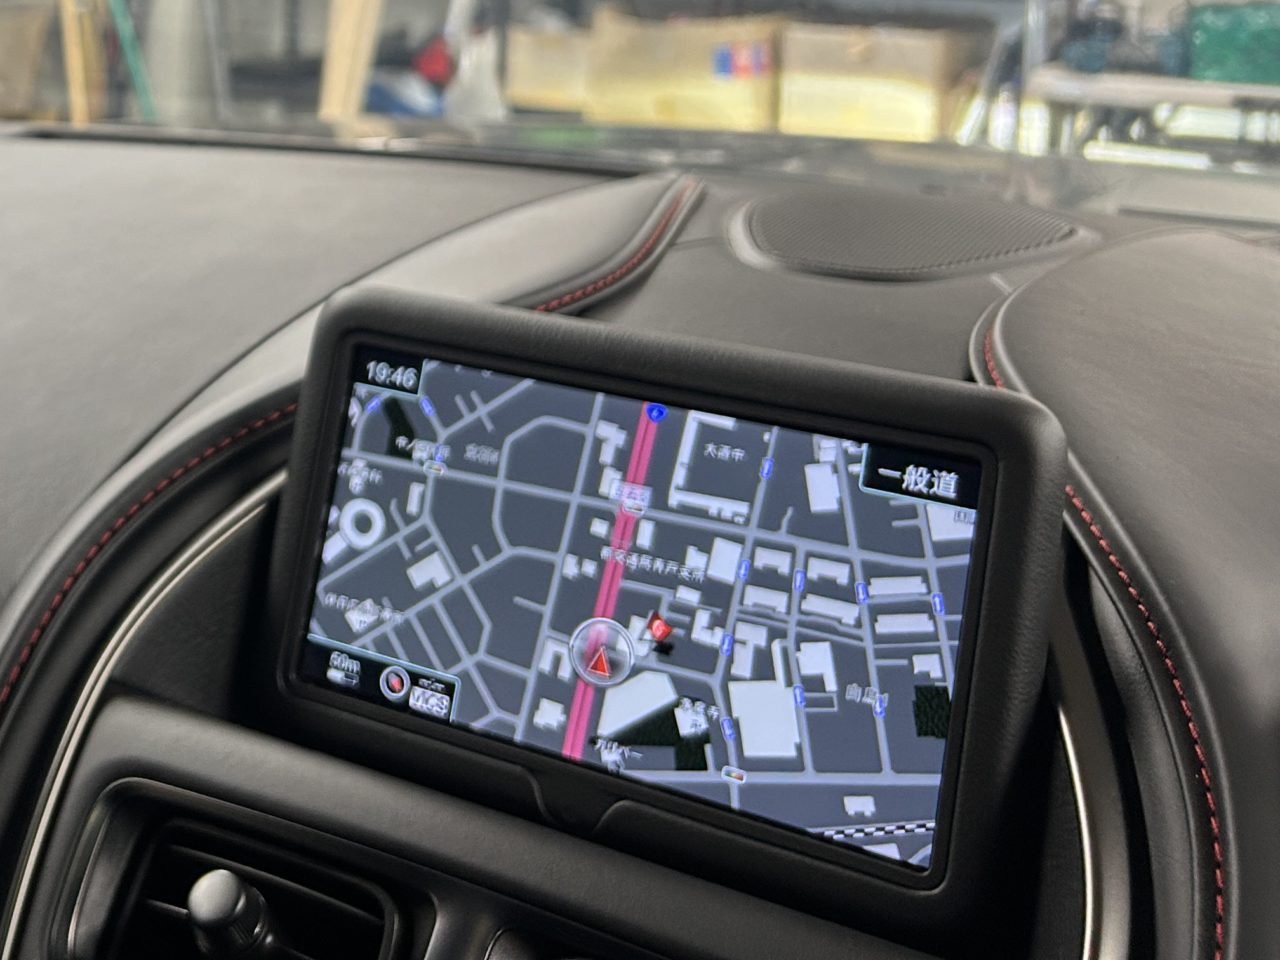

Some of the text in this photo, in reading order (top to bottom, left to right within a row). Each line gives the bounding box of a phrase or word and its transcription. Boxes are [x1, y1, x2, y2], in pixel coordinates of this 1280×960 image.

[367, 360, 418, 389] 19:46
[878, 464, 959, 498] 一般道
